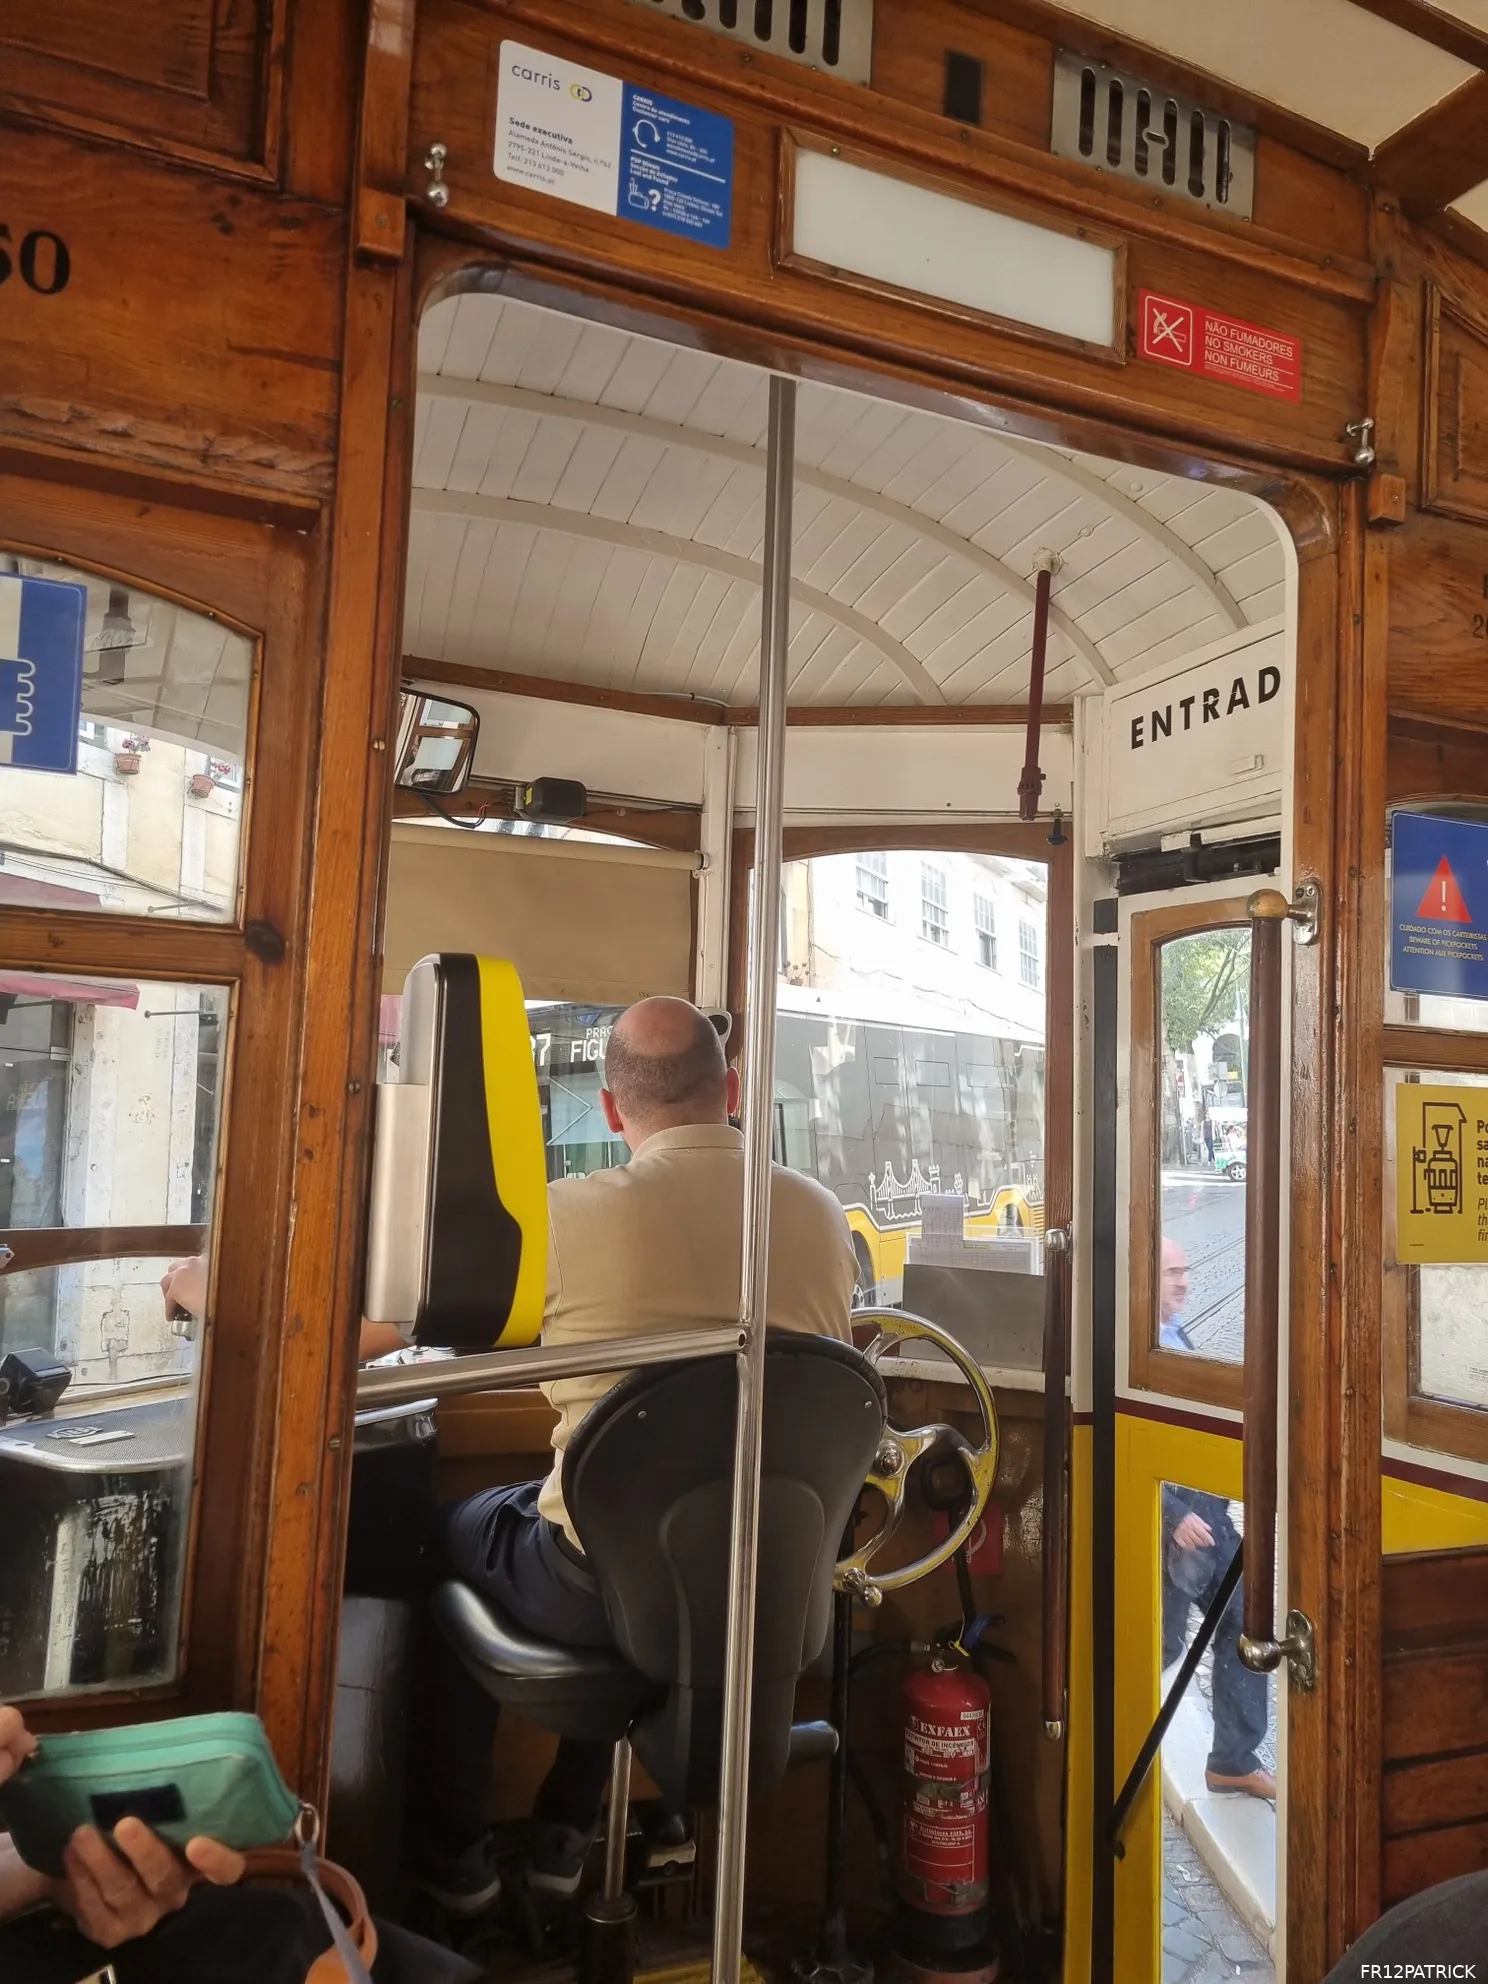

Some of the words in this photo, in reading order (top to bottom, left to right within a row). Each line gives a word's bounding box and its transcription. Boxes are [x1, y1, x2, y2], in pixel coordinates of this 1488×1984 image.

[511, 65, 561, 91] carris
[508, 130, 539, 145] Alameda
[509, 117, 531, 130] Sede
[532, 126, 573, 145] executiva
[508, 141, 540, 156] 2795-221
[524, 157, 536, 167] 213
[1205, 320, 1228, 336] NÃO
[1230, 329, 1293, 358] FUMADORES
[1205, 335, 1221, 349] NO
[1223, 342, 1273, 365] SMOKERS
[1204, 350, 1228, 366] NON
[1230, 357, 1279, 382] FUMEURS
[1399, 924, 1427, 934] CUIDADO
[1427, 928, 1442, 936] COM
[1409, 936, 1432, 945] BEWARE
[1432, 938, 1441, 946] OF
[1441, 940, 1478, 950] PICKPOCKETS
[1402, 946, 1434, 956] ATTENTION
[920, 1722, 970, 1738] EXFAEX
